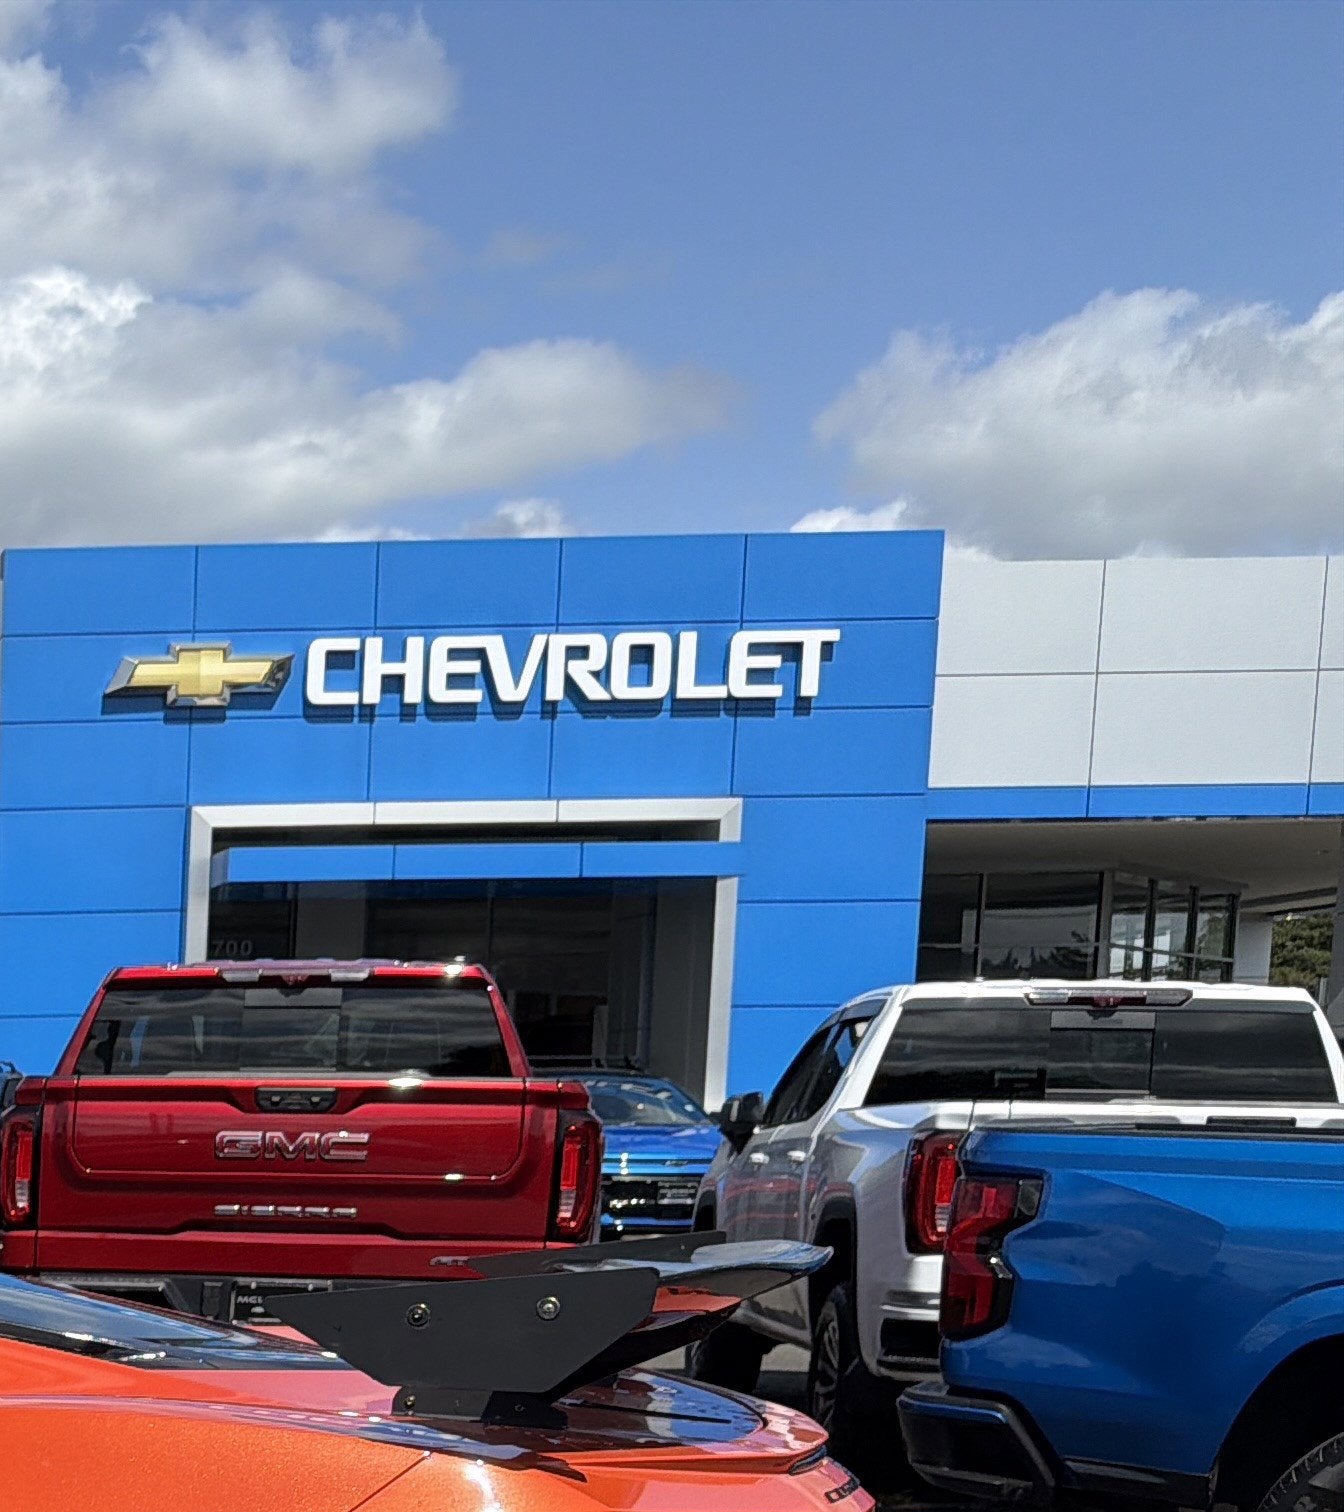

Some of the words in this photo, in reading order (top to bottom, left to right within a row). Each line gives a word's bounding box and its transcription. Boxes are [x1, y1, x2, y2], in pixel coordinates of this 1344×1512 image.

[307, 628, 841, 706] CHEVROLET
[215, 1130, 370, 1160] GMC
[214, 1204, 358, 1218] SIERRA
